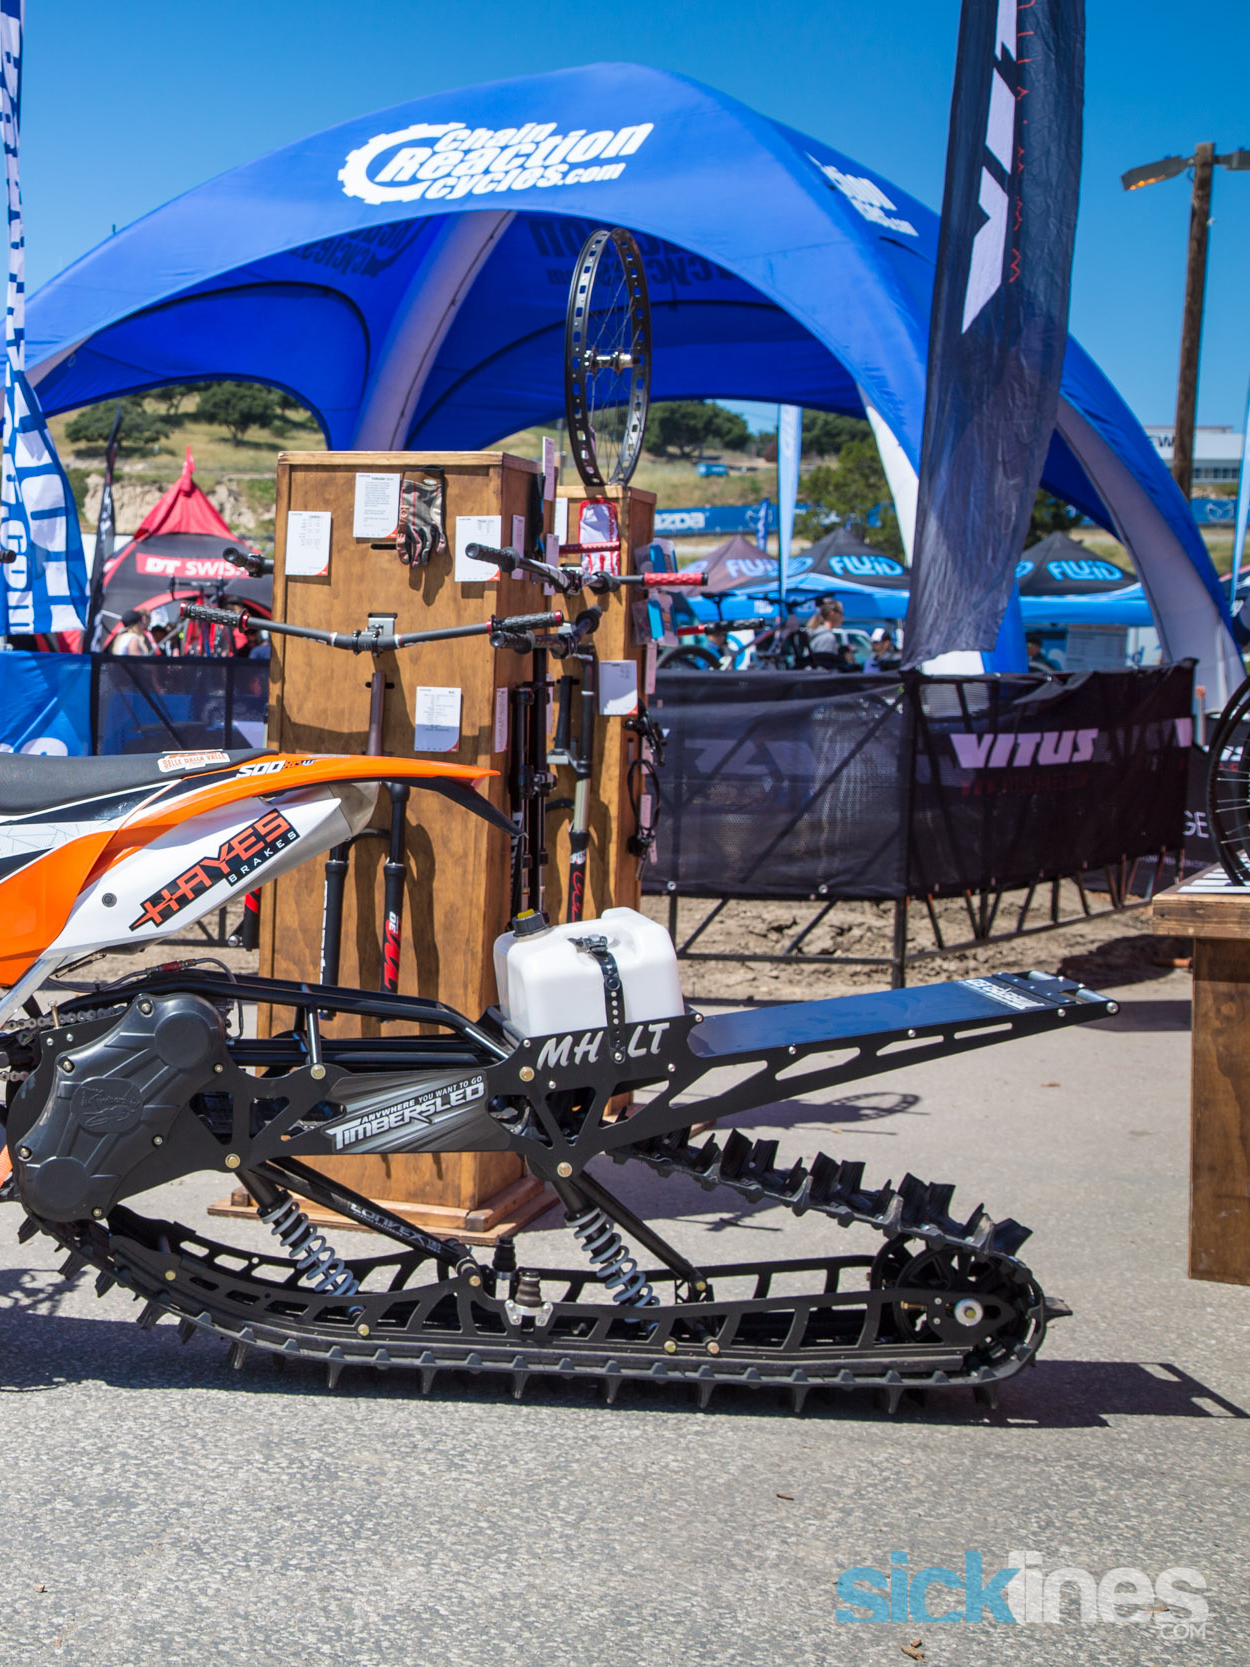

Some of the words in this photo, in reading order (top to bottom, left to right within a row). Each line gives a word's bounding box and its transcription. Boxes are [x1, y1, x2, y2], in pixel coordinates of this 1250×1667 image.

[374, 123, 654, 182] Reaction
[433, 122, 558, 153] Chain
[424, 162, 626, 200] cycles.com
[145, 557, 181, 575] DT
[185, 561, 245, 577] SWIS
[162, 759, 182, 769] SELLE
[184, 756, 205, 764] DALLA
[206, 752, 227, 761] VALLE
[236, 760, 287, 778] 500
[950, 728, 1099, 769] VITUS
[138, 811, 290, 925] HAYES
[228, 831, 297, 884] BRAKES
[536, 1032, 604, 1072] MH
[627, 1022, 670, 1058] LT
[361, 1099, 416, 1124] ANYWHERE
[418, 1093, 435, 1103] YOU
[435, 1084, 458, 1098] WANT
[459, 1080, 469, 1089] TO
[471, 1075, 483, 1085] GO
